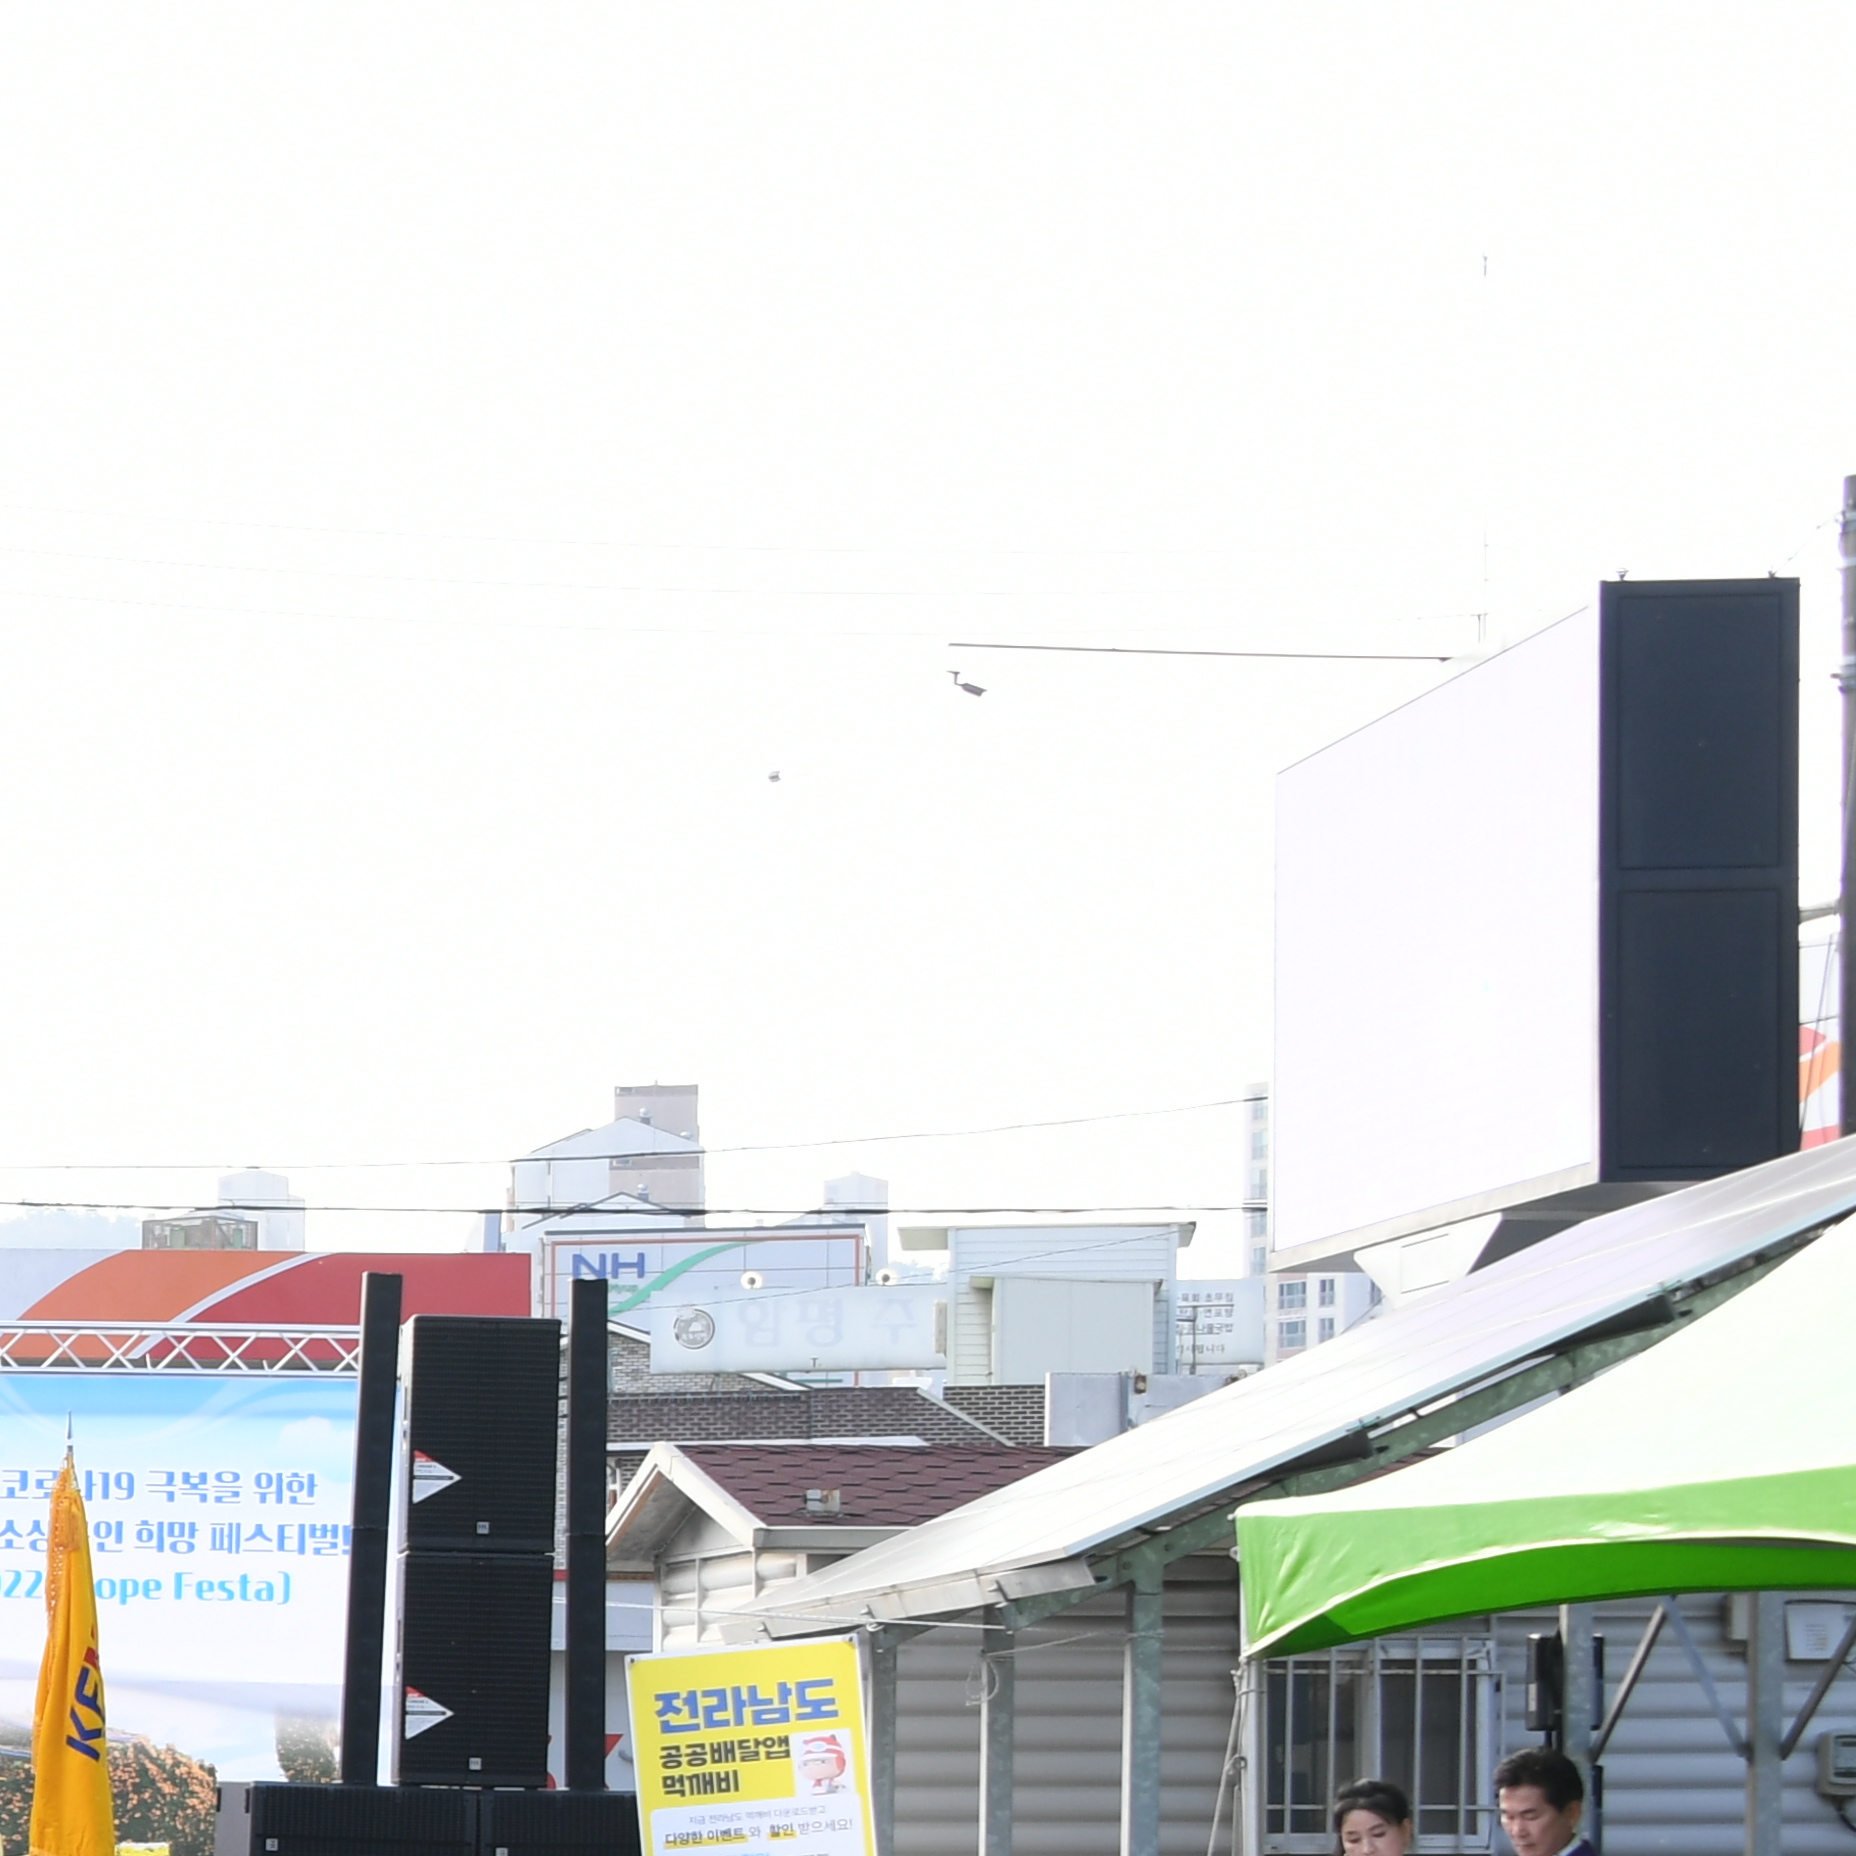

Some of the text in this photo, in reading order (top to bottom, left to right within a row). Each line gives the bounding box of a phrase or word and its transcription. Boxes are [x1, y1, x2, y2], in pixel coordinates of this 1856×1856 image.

[572, 1252, 646, 1281] NH
[145, 1470, 243, 1505] 극복을
[253, 1472, 318, 1506] 위한
[134, 1519, 199, 1555] 희망
[95, 1573, 162, 1605] ope
[173, 1571, 292, 1606] Festa)
[654, 1678, 840, 1735] 전라남도
[659, 1734, 792, 1771] 공공배달앱
[662, 1769, 741, 1798] 먹깨비
[664, 1818, 854, 1846] 다양한 이벤트 와 할인 받으세요!
